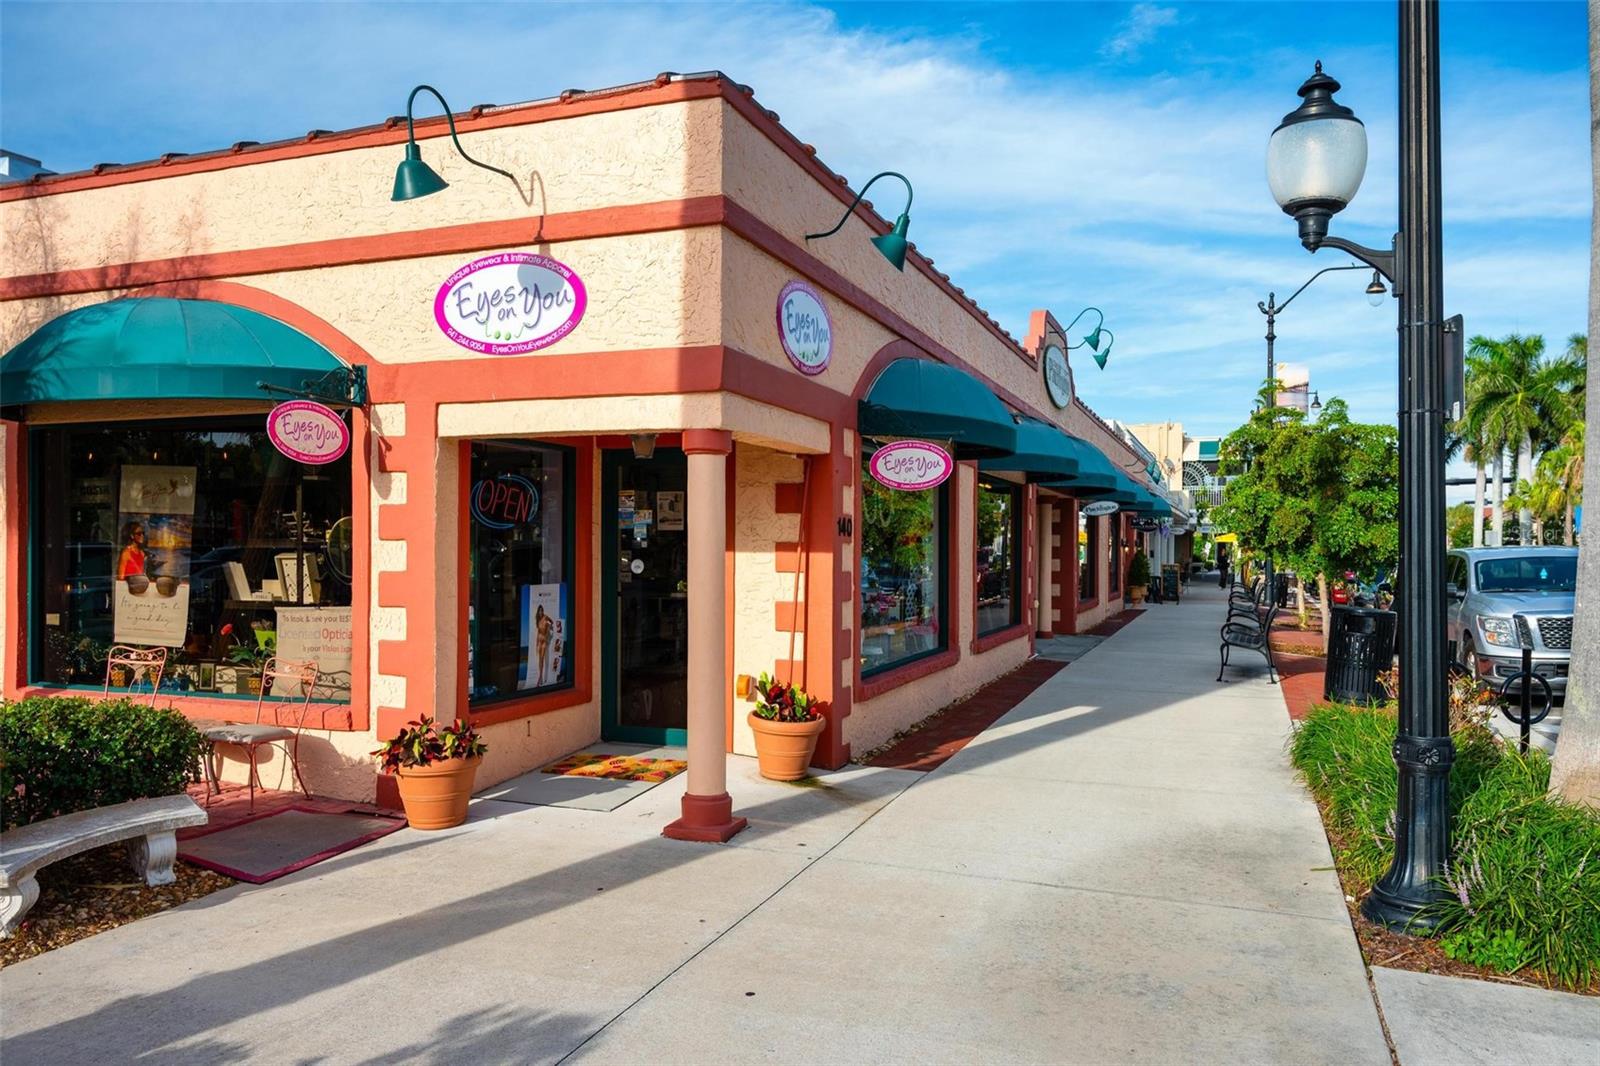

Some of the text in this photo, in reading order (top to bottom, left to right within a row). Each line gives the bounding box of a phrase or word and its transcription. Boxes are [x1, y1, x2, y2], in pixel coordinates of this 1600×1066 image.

[446, 254, 572, 287] Unique Eyewear & Intimate Apparel
[452, 281, 572, 329] Eyes on You
[492, 320, 573, 355] EyesOnYouEyewear.com
[784, 298, 810, 344] Eyes
[803, 331, 811, 344] on
[810, 316, 829, 357] You
[281, 412, 314, 441] Eyes
[303, 433, 314, 441] on
[314, 423, 340, 449] You
[882, 453, 942, 478] Eyes on You
[479, 480, 531, 522] OPEN
[837, 516, 853, 537] 140
[323, 616, 337, 624] your
